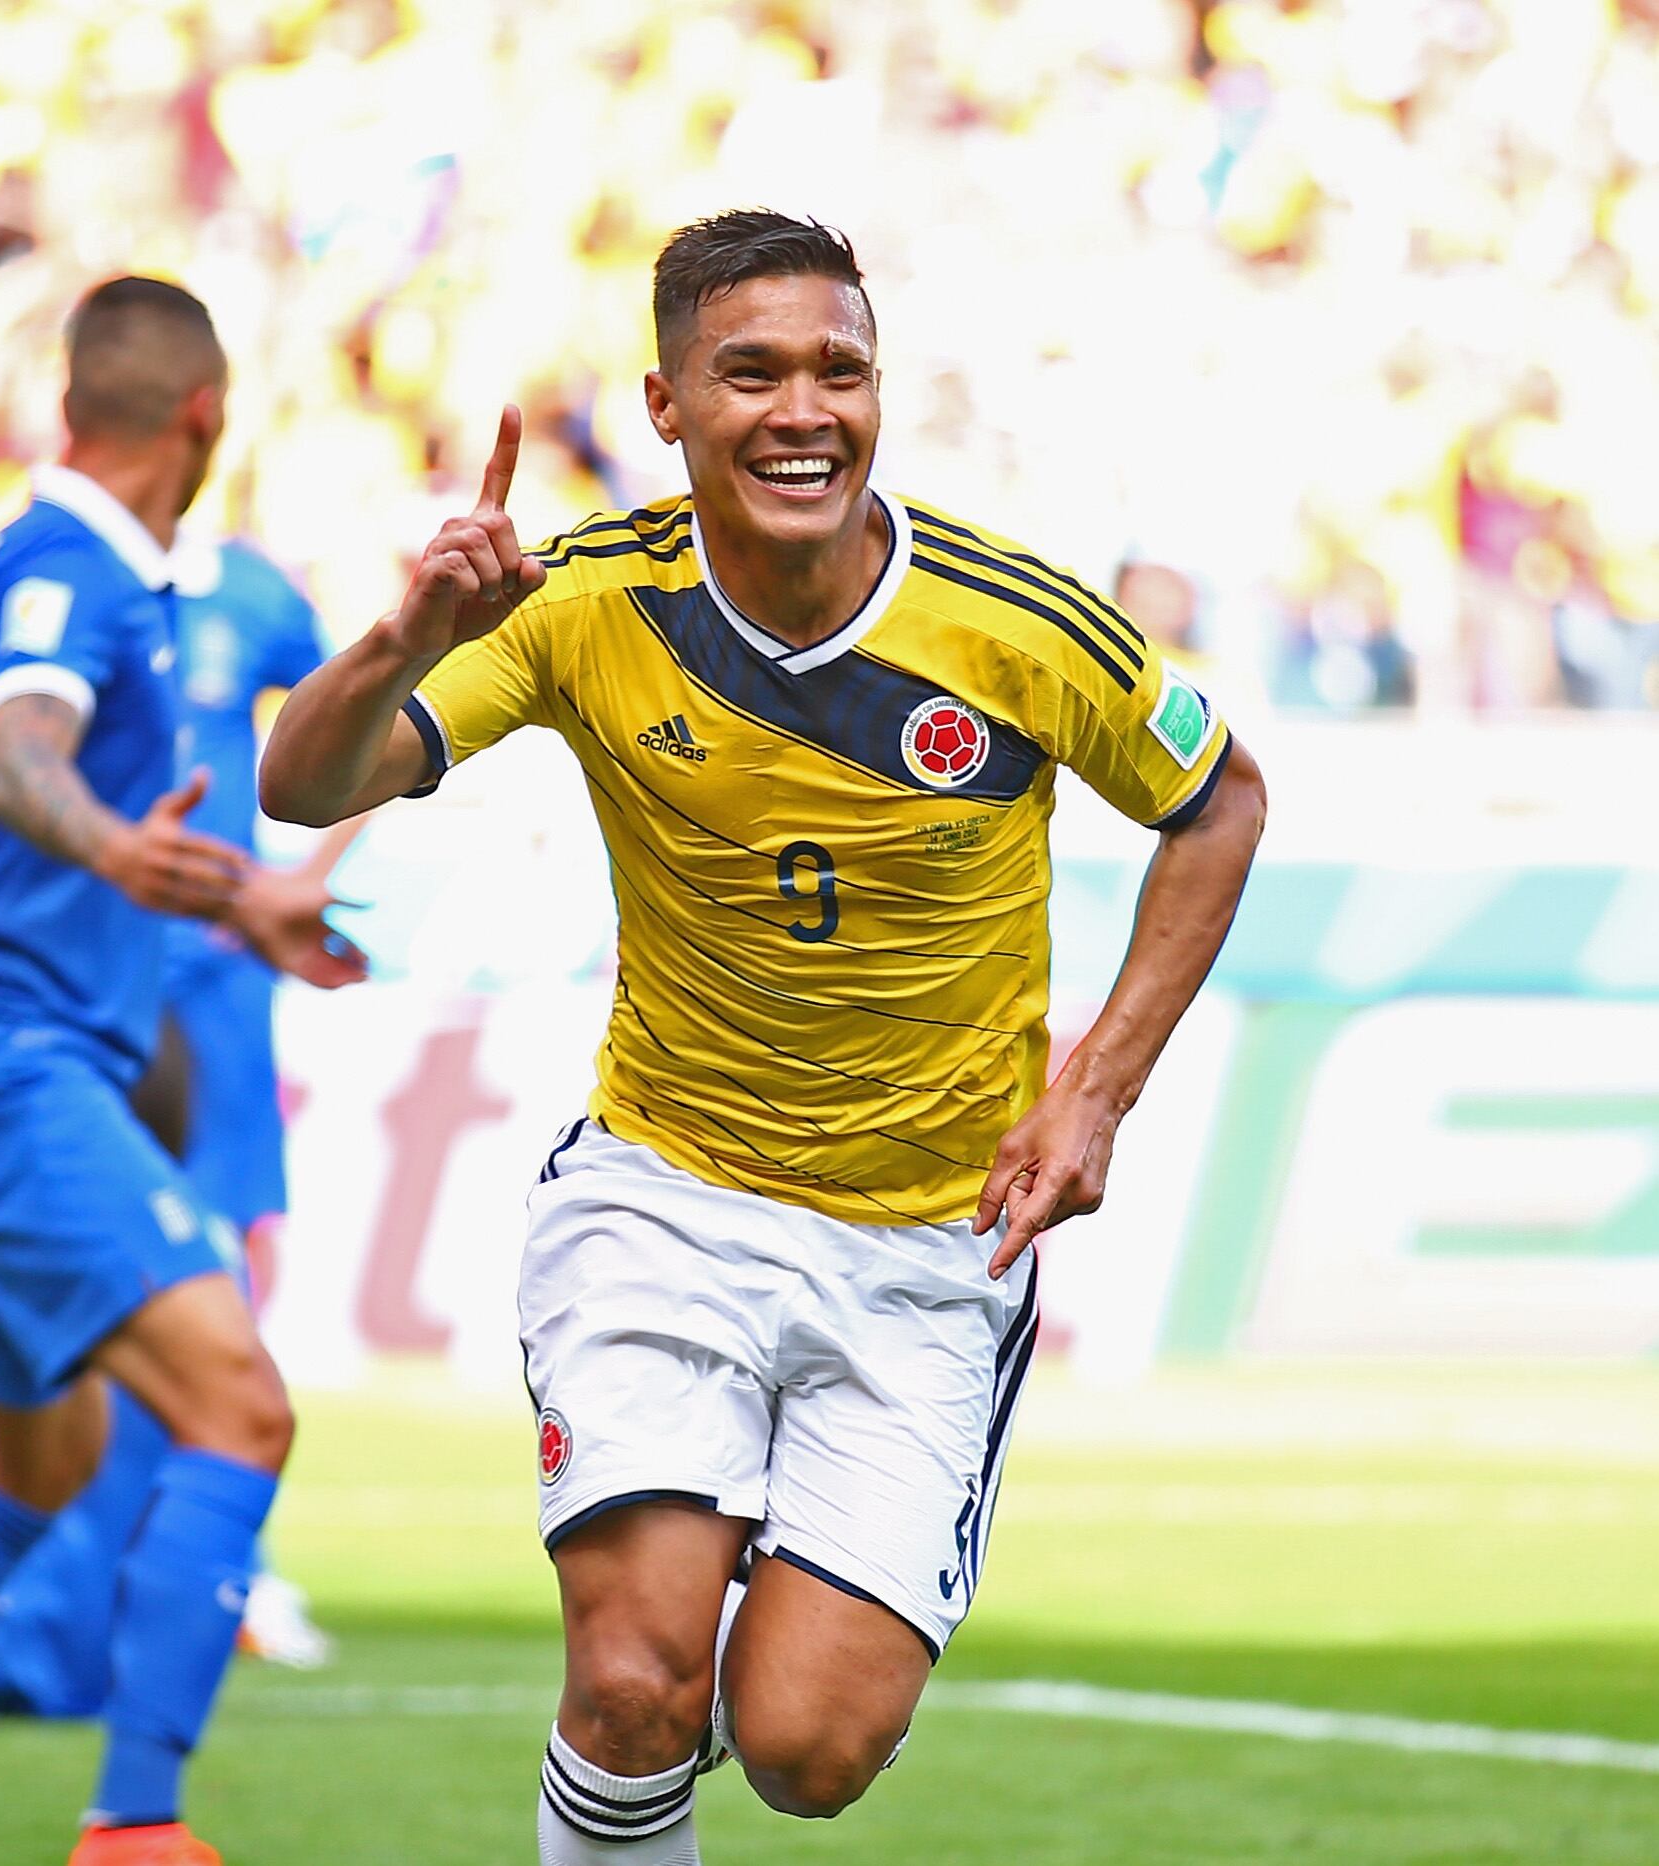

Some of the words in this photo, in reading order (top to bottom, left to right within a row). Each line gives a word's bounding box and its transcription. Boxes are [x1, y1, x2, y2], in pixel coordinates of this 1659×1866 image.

[636, 732, 707, 762] adidas
[915, 821, 953, 835] COLOMBIA
[777, 840, 839, 943] 9
